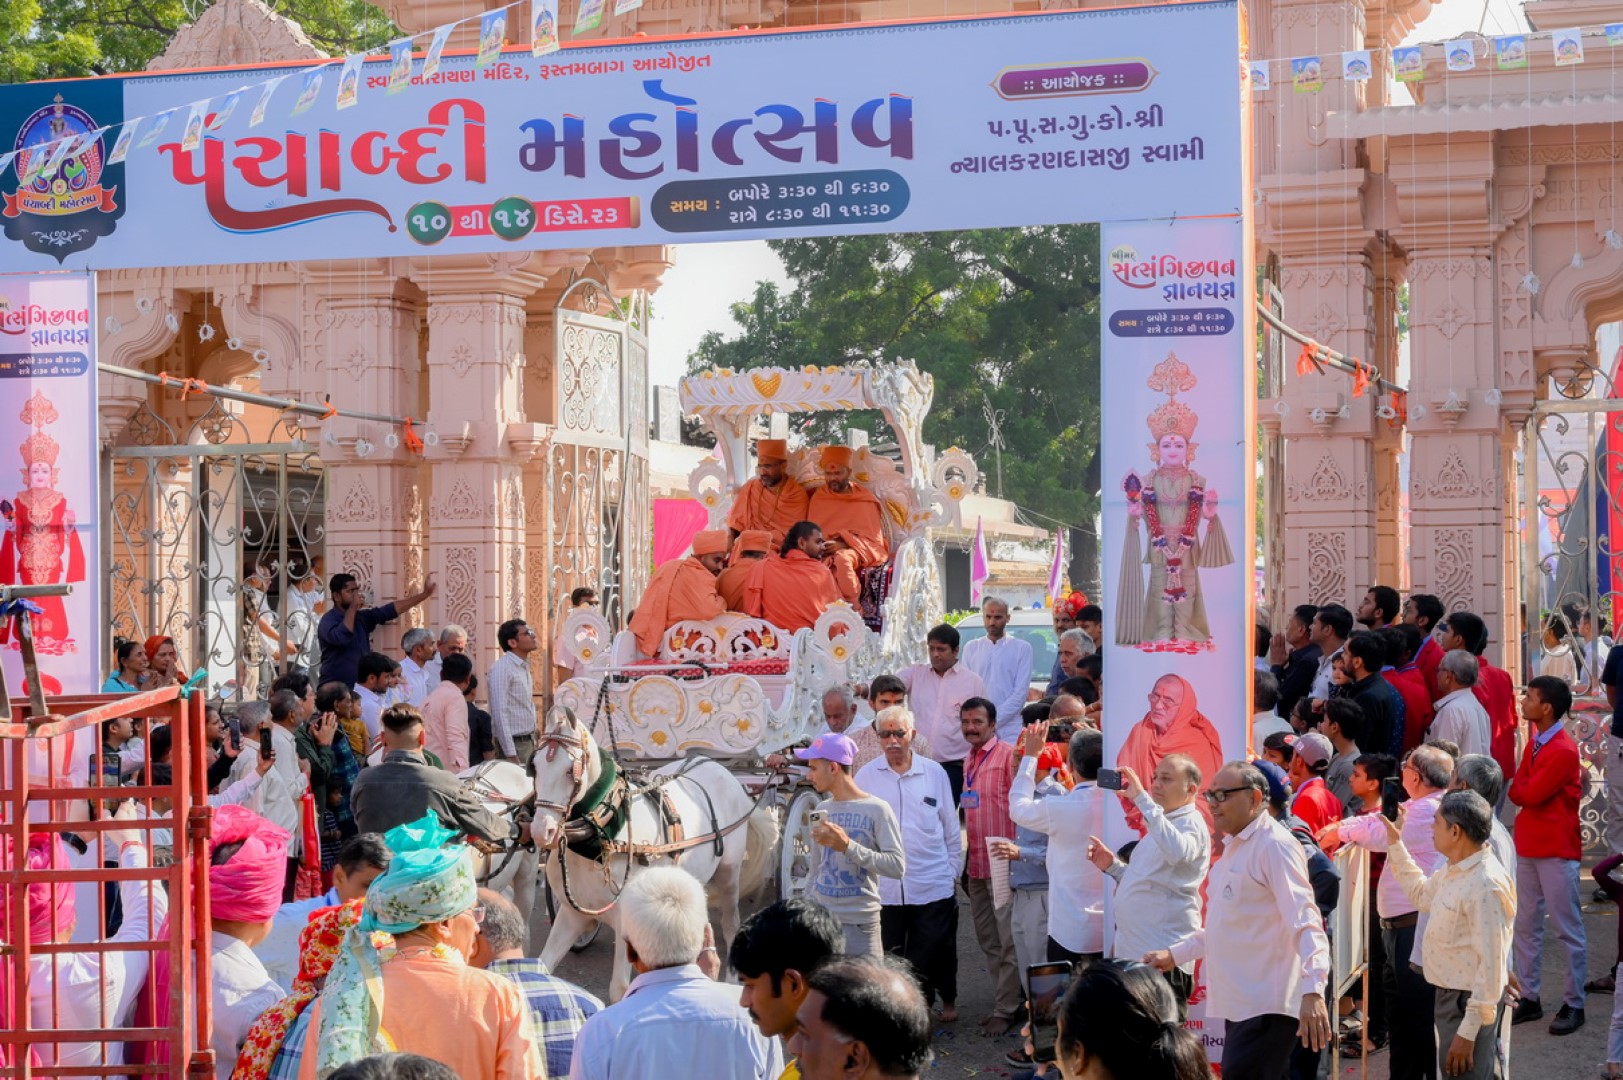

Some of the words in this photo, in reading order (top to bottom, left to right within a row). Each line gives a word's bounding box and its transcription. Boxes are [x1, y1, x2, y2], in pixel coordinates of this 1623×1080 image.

[366, 69, 476, 89] સ્વાનારાયણ
[483, 62, 530, 81] મંદિર,
[539, 60, 625, 80] રૂસ્તમબાગ
[632, 51, 712, 72] આયોજીત
[1041, 71, 1106, 90] આયોજક
[157, 98, 487, 234] પંચાબ્દી
[518, 79, 914, 180] મહોત્સવ
[949, 146, 1130, 174] ન્યાલકરણદાસજી
[1142, 136, 1205, 163] સ્વામી
[728, 183, 770, 202] બપોરે
[778, 185, 817, 198] ૩:૩૦
[824, 179, 843, 196] થી
[670, 200, 708, 213] સમય
[729, 206, 758, 223] રાત્રે
[812, 203, 831, 219] થી
[839, 203, 891, 217] ૧૧:૩૦
[412, 214, 447, 233] ૧૦
[459, 208, 484, 230] થી
[494, 207, 532, 227] ૧૪
[1112, 254, 1236, 289] સત્સંગિજીવન
[1162, 281, 1236, 302] જ્ઞાનયજ્ઞ
[31, 328, 89, 346] જ્ઞાનયજ્ઞ
